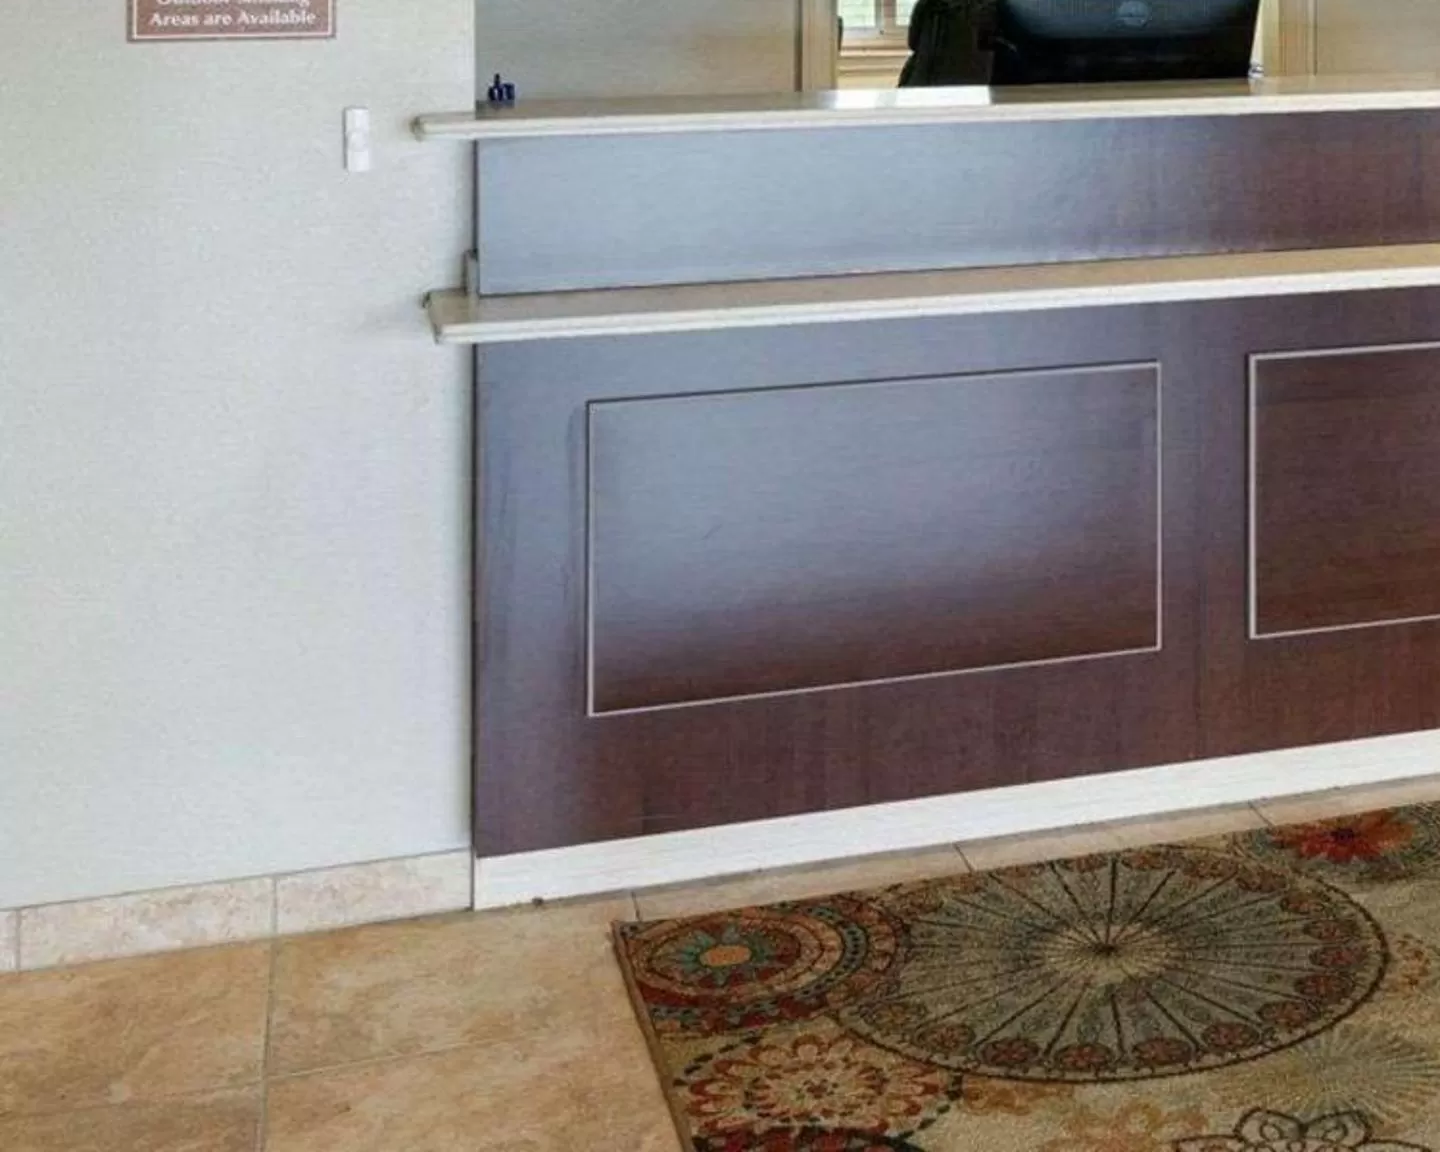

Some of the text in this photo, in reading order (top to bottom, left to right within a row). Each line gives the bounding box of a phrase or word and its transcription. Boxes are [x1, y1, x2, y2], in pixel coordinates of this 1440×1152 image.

[150, 10, 316, 26] Areas are Available
